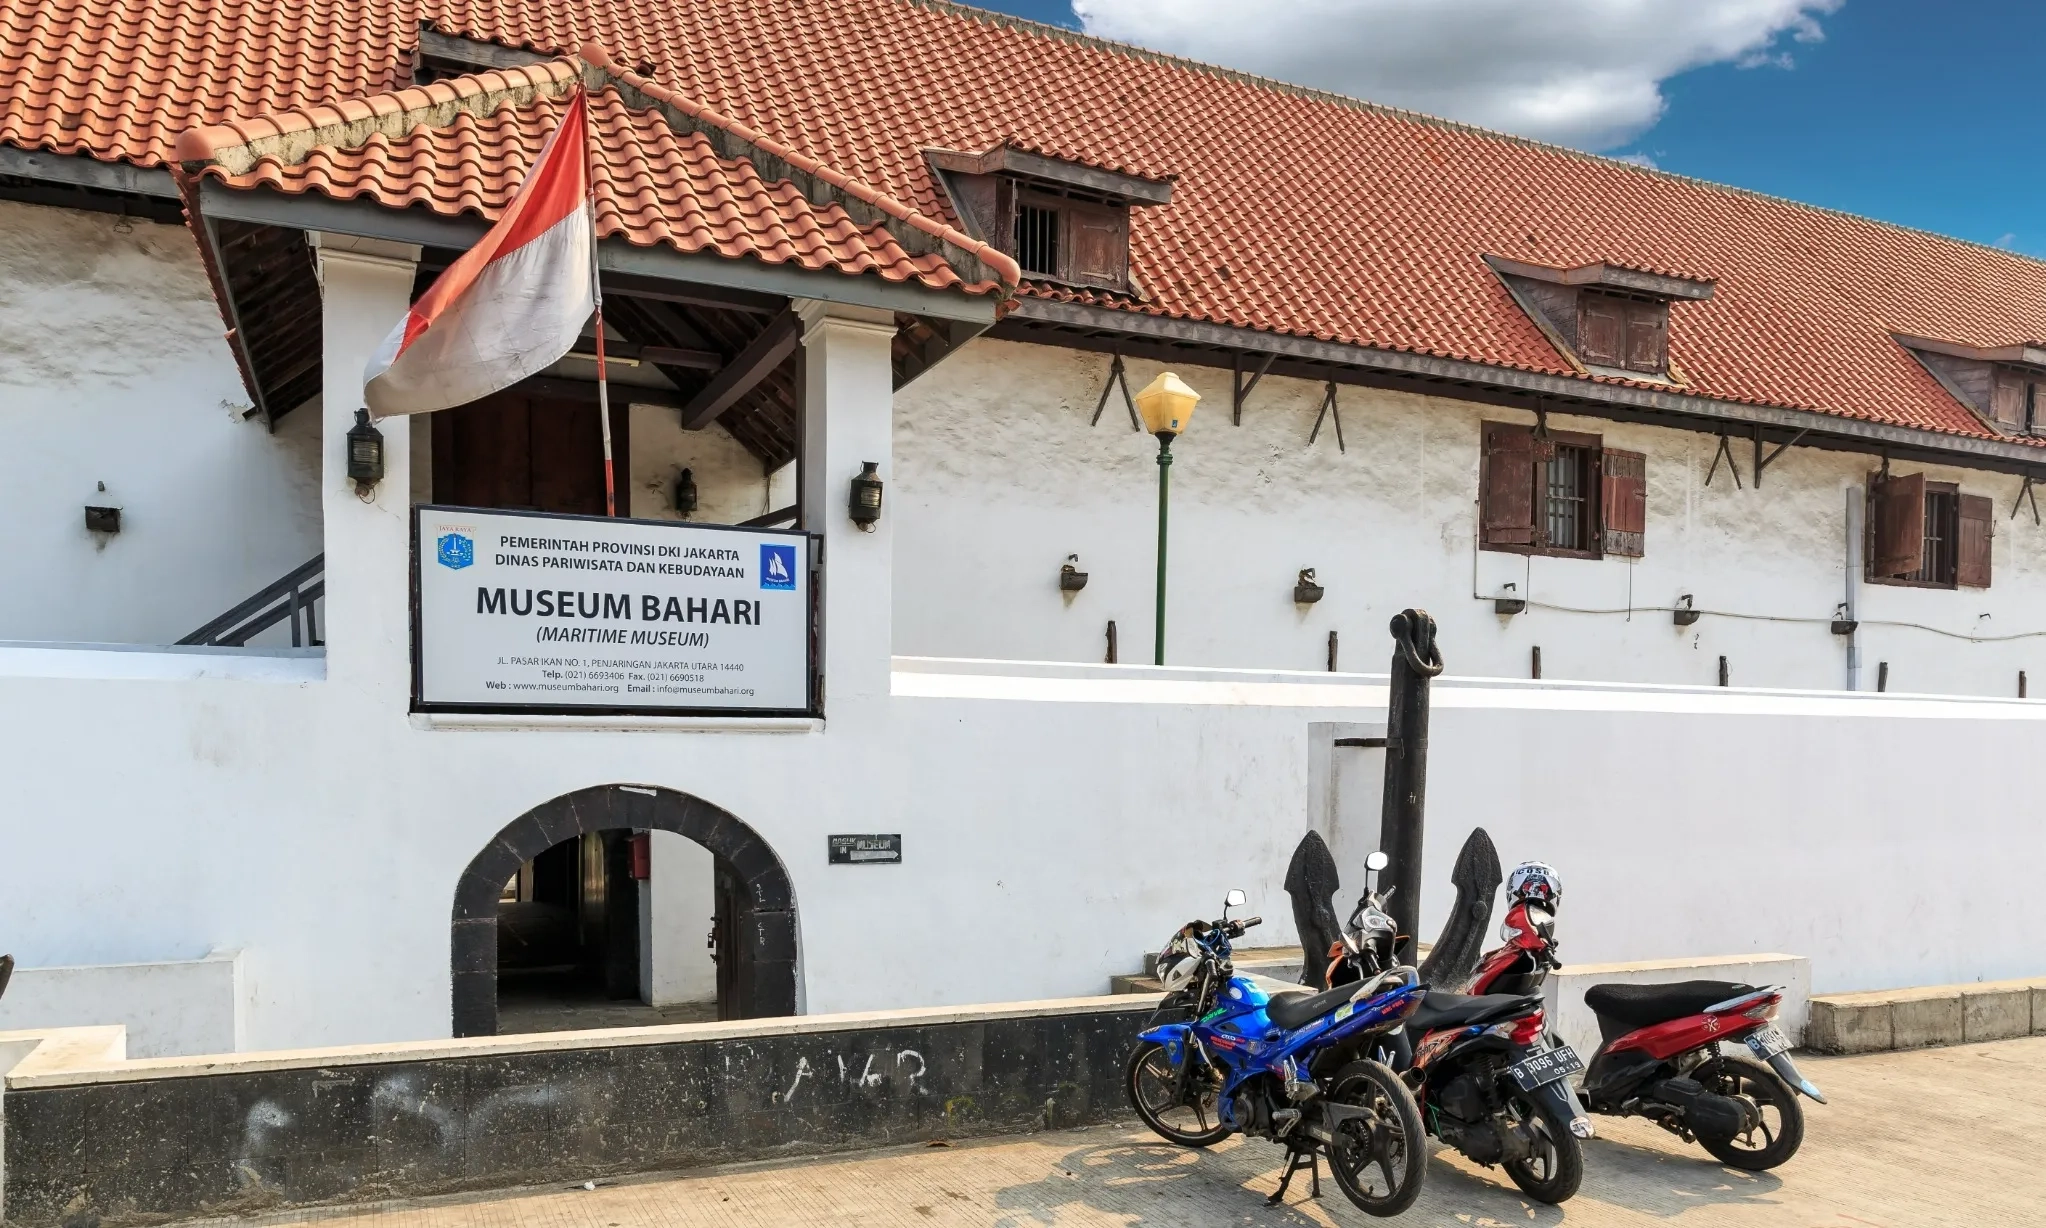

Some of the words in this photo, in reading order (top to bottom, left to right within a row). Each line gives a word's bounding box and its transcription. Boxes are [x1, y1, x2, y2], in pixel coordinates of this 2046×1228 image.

[500, 535, 589, 552] PEMERINTAH
[592, 541, 655, 556] PROVINSI
[658, 545, 681, 558] DKI
[683, 547, 740, 561] JAKARTA
[495, 553, 539, 567] DINAS
[542, 557, 623, 572] PARIWISATA
[626, 561, 656, 574] DAN
[658, 563, 745, 579] KEBUDAYAAN
[476, 586, 632, 620] MUSEUM
[641, 594, 761, 626] BAHARI
[536, 625, 628, 645] (MARITIME
[630, 629, 710, 649] MUSEUM)
[497, 656, 509, 665] JL.
[510, 657, 539, 666] PASAR
[541, 658, 563, 666] IKAN
[564, 658, 581, 667] NO.
[583, 659, 590, 668] 1,
[591, 659, 652, 669] PENJARINGAN
[653, 661, 689, 670] JAKARTA
[691, 663, 718, 671] UTARA
[720, 663, 744, 672] 14440
[541, 670, 563, 680] Telp.
[565, 670, 587, 680] (021)
[588, 671, 625, 680] 6693406
[628, 673, 646, 681] Fax.
[647, 673, 668, 682] (021)
[669, 674, 705, 682] 6690518
[485, 681, 506, 690] Web
[513, 683, 619, 693] www.museumbahari.org
[627, 684, 651, 693] Email
[656, 685, 755, 697] info@museumbahari.org
[839, 846, 847, 854] IN
[856, 840, 891, 850] MUSEUM
[1748, 1038, 1760, 1050] B
[1514, 1067, 1525, 1079] B
[1526, 1056, 1554, 1073] 3096
[1554, 1047, 1576, 1063] UFH
